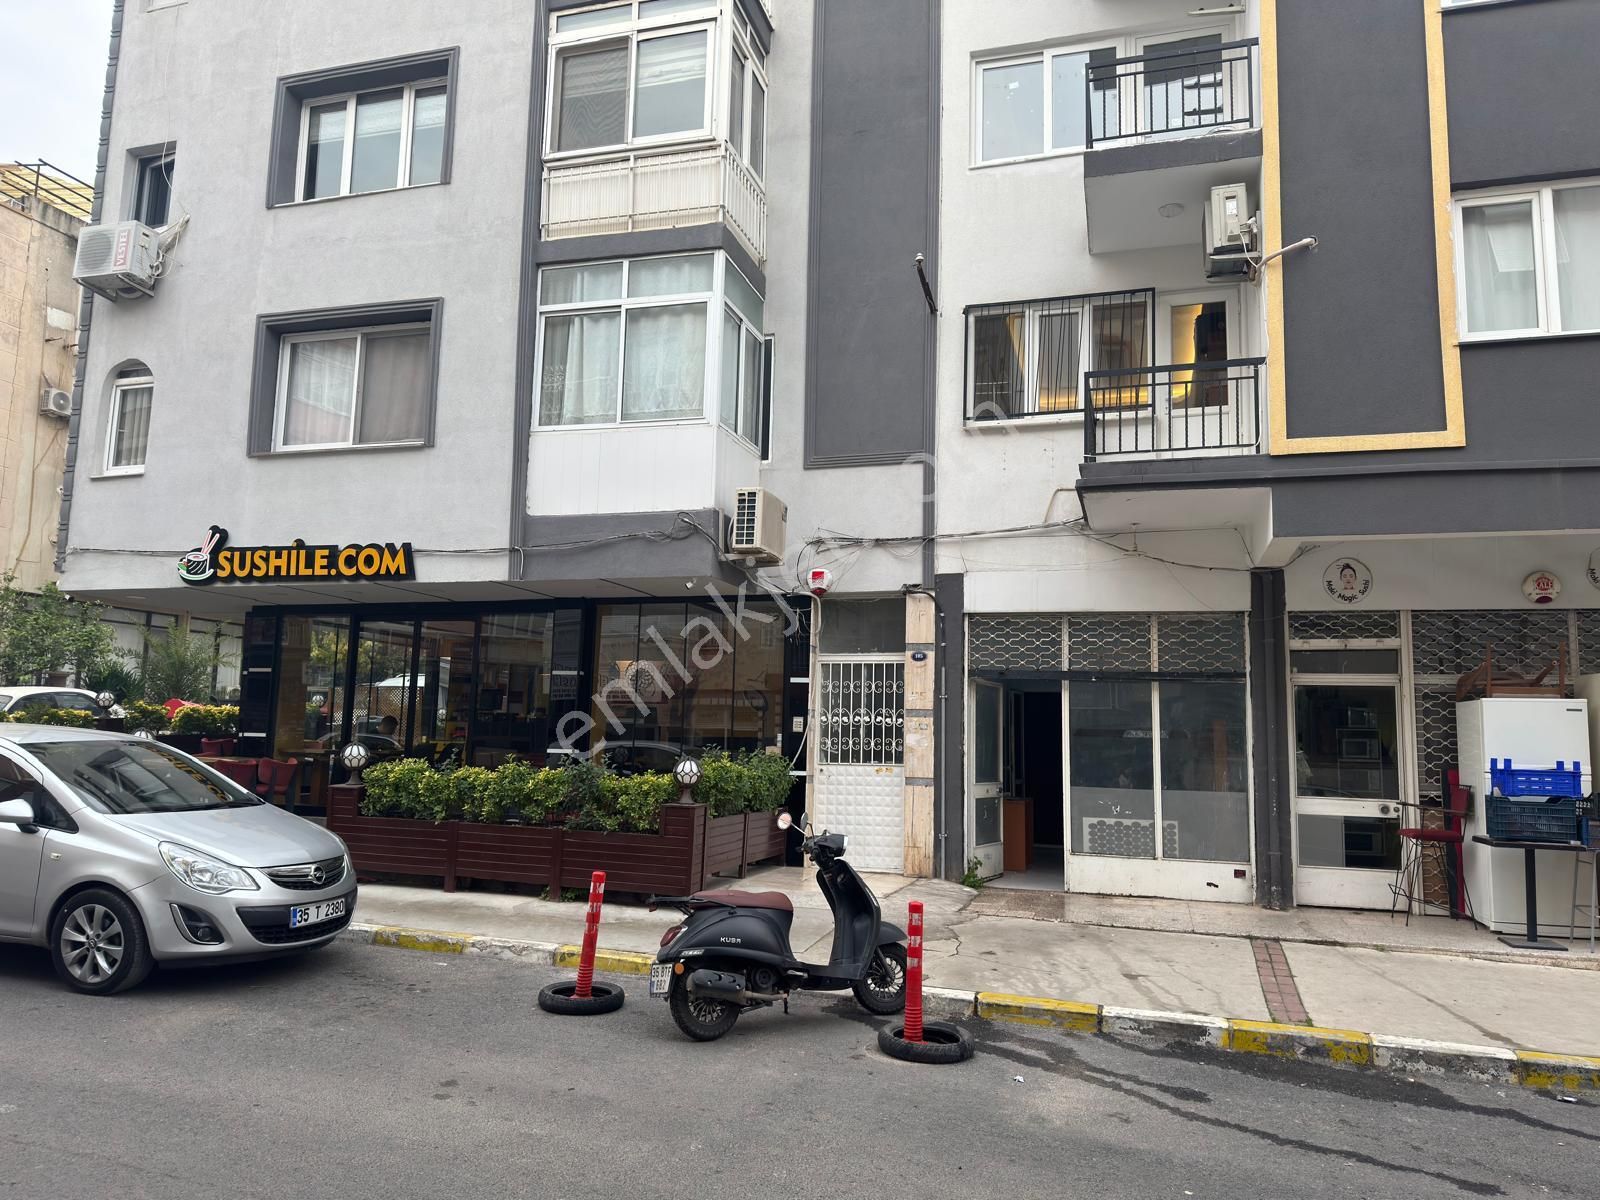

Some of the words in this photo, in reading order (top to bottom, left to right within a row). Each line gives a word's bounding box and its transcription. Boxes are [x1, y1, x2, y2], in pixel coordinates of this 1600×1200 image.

[115, 230, 129, 266] VESTEL
[1337, 593, 1358, 603] Magic
[1359, 579, 1370, 595] Sushi
[297, 908, 310, 924] 35
[315, 905, 322, 919] T
[325, 899, 344, 917] 2380
[720, 936, 742, 944] KUBA
[652, 966, 660, 978] 35
